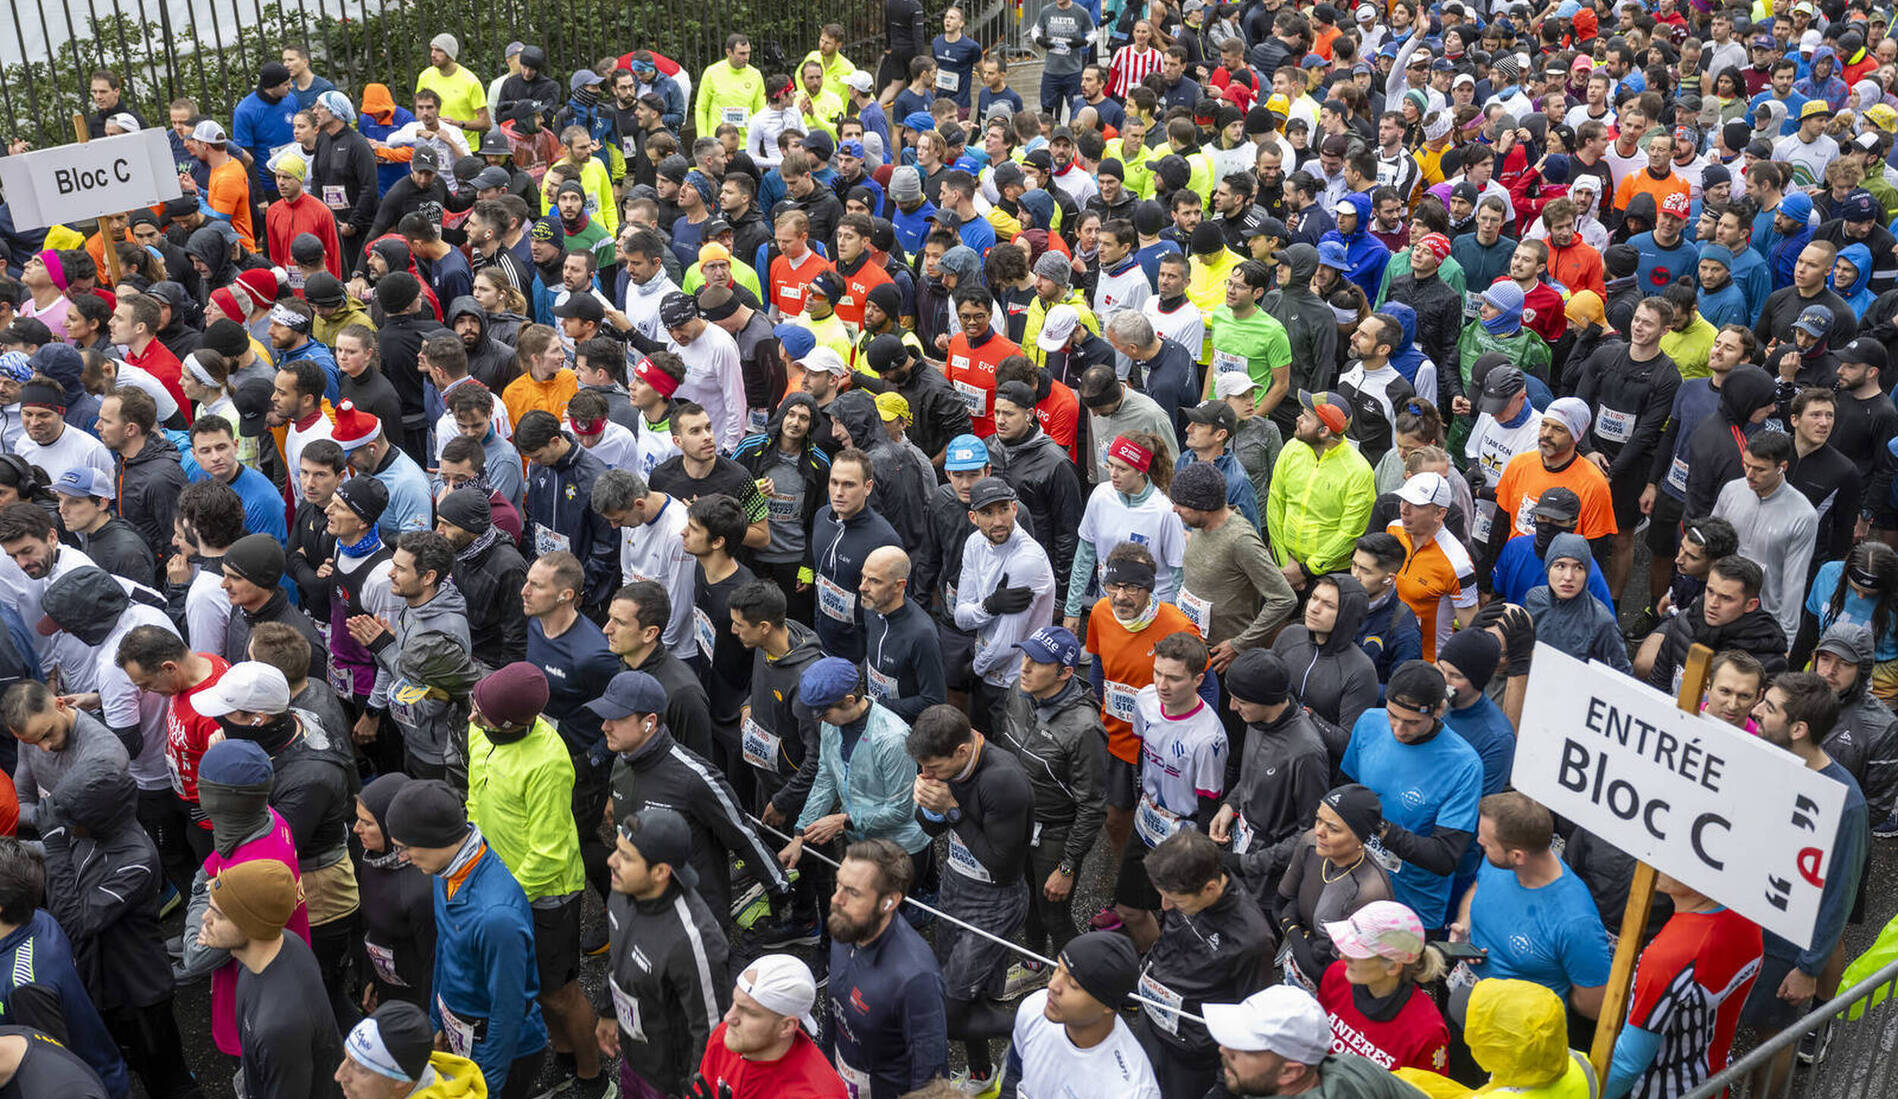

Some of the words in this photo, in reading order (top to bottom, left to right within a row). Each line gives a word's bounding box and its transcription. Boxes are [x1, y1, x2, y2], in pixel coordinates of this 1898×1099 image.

[55, 168, 108, 194] Bloc
[114, 158, 131, 183] C
[978, 361, 994, 374] EFG
[1610, 412, 1626, 421] UBS
[1484, 435, 1499, 449] TEAM
[1115, 702, 1135, 713] 510
[1586, 696, 1725, 793] ENTRÉE
[1557, 737, 1670, 841] Bloc
[1690, 812, 1732, 872] C
[1328, 1012, 1395, 1069] ANIÈRES
